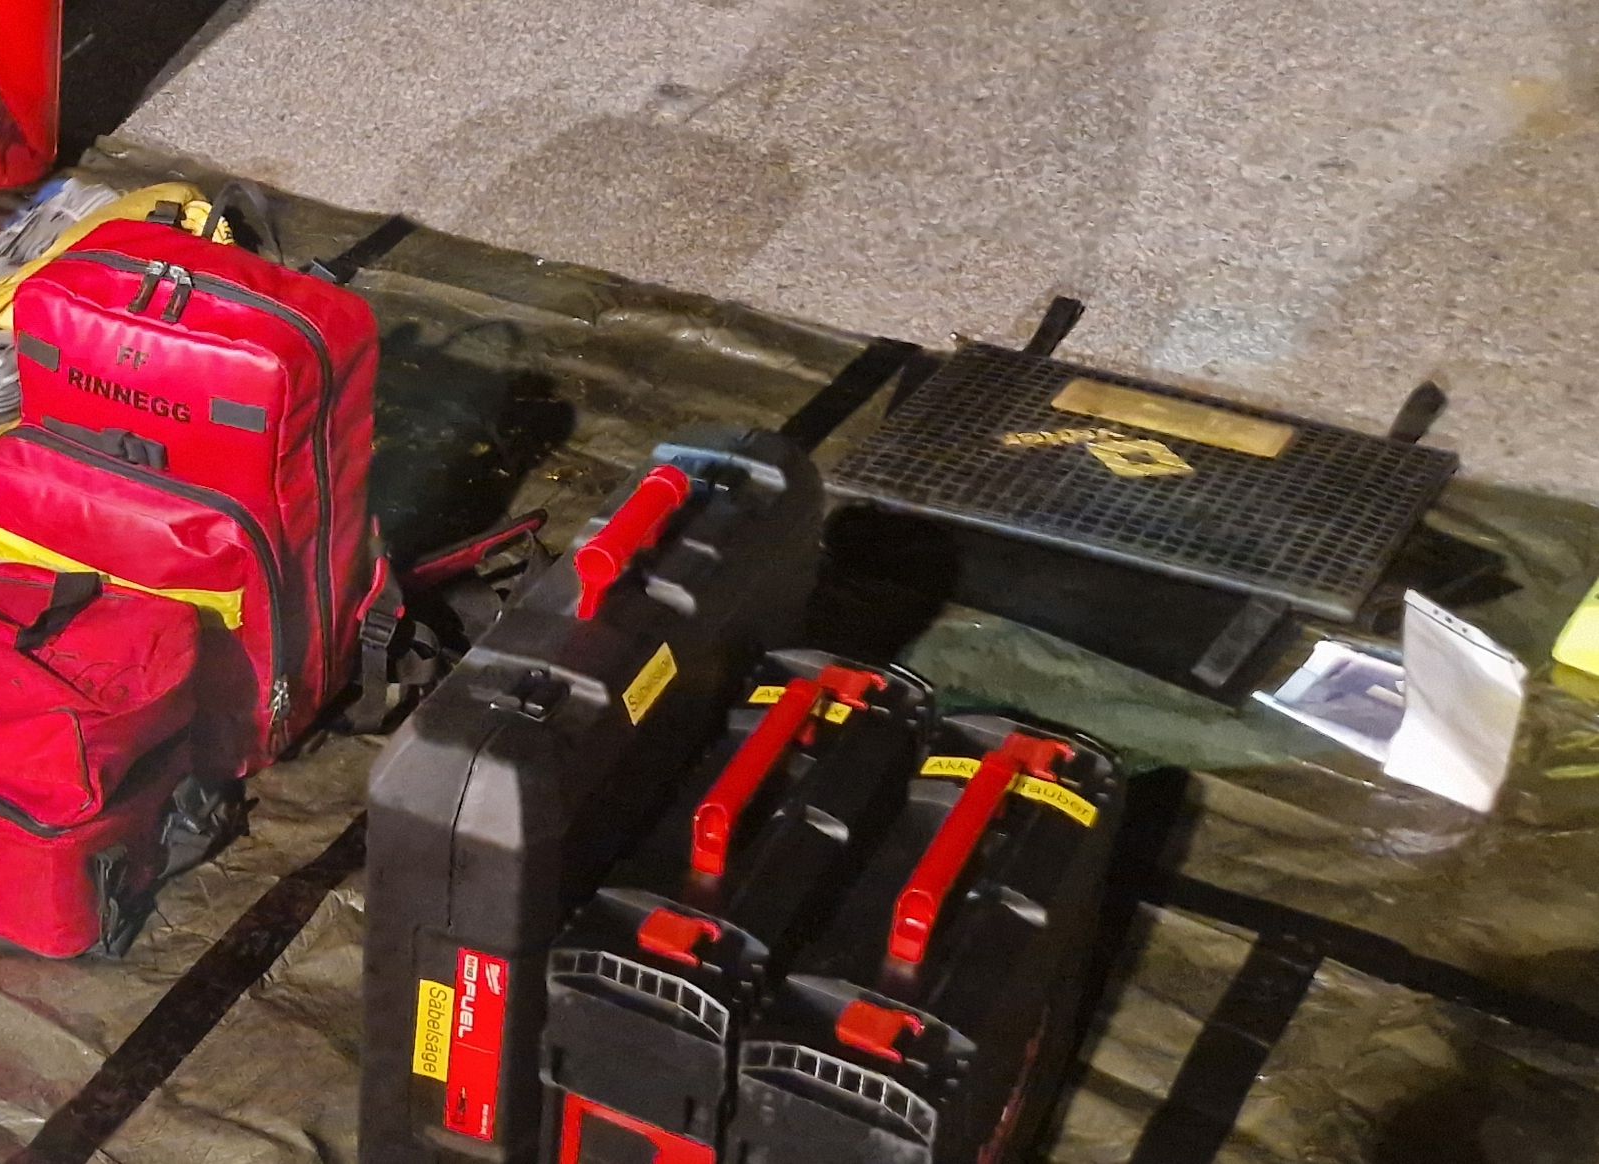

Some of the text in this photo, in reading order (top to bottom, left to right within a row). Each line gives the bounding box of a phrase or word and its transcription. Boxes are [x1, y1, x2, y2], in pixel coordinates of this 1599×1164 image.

[116, 344, 150, 370] FF
[67, 366, 191, 424] RINNEGG
[421, 986, 447, 1073] Säbelsäge
[457, 980, 478, 1038] FUEL
